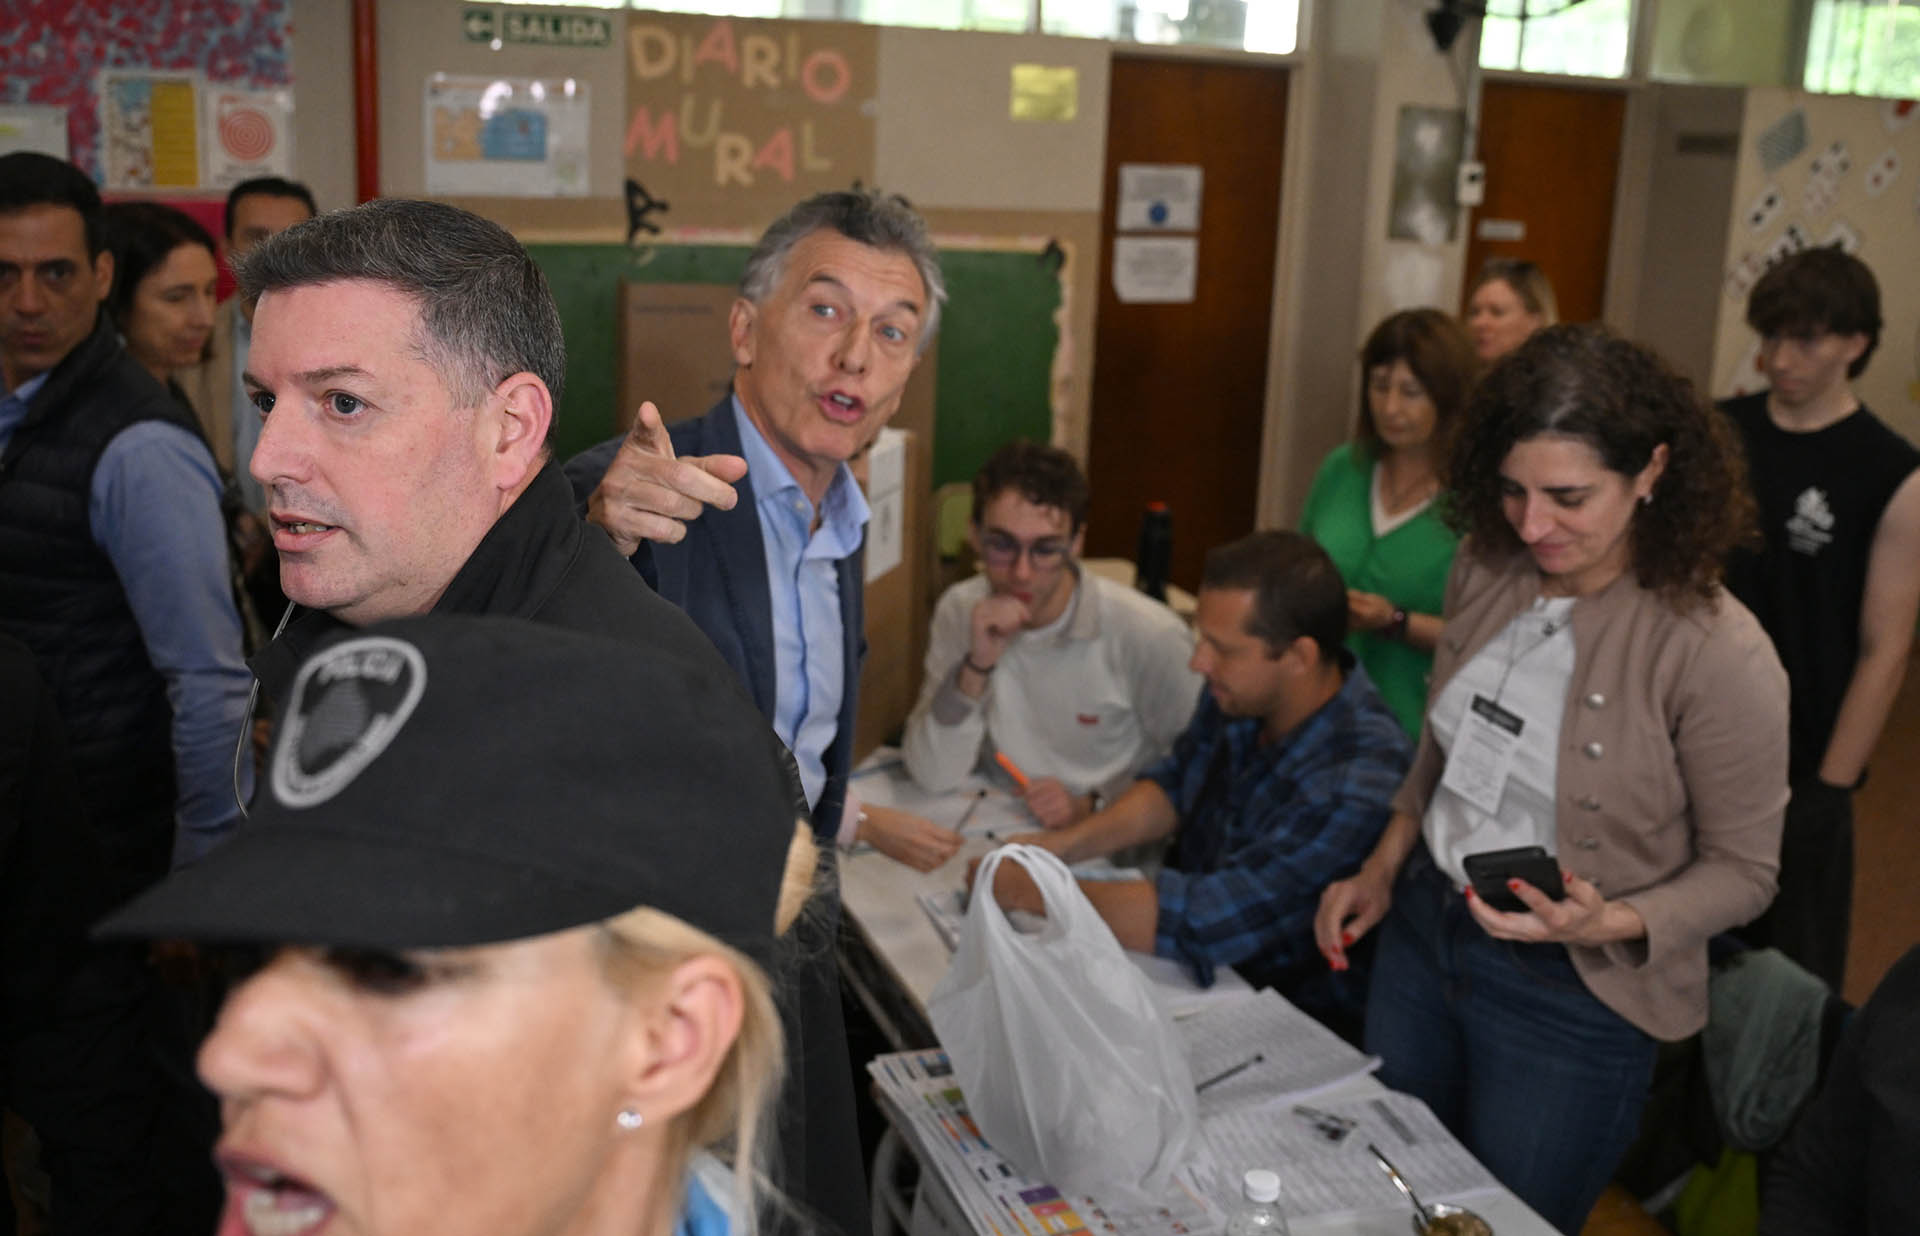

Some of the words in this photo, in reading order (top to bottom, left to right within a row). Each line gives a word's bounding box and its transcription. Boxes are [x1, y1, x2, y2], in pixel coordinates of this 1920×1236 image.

[505, 17, 609, 43] SALIDA
[630, 20, 851, 101] DIARIO
[625, 95, 833, 186] MURAL
